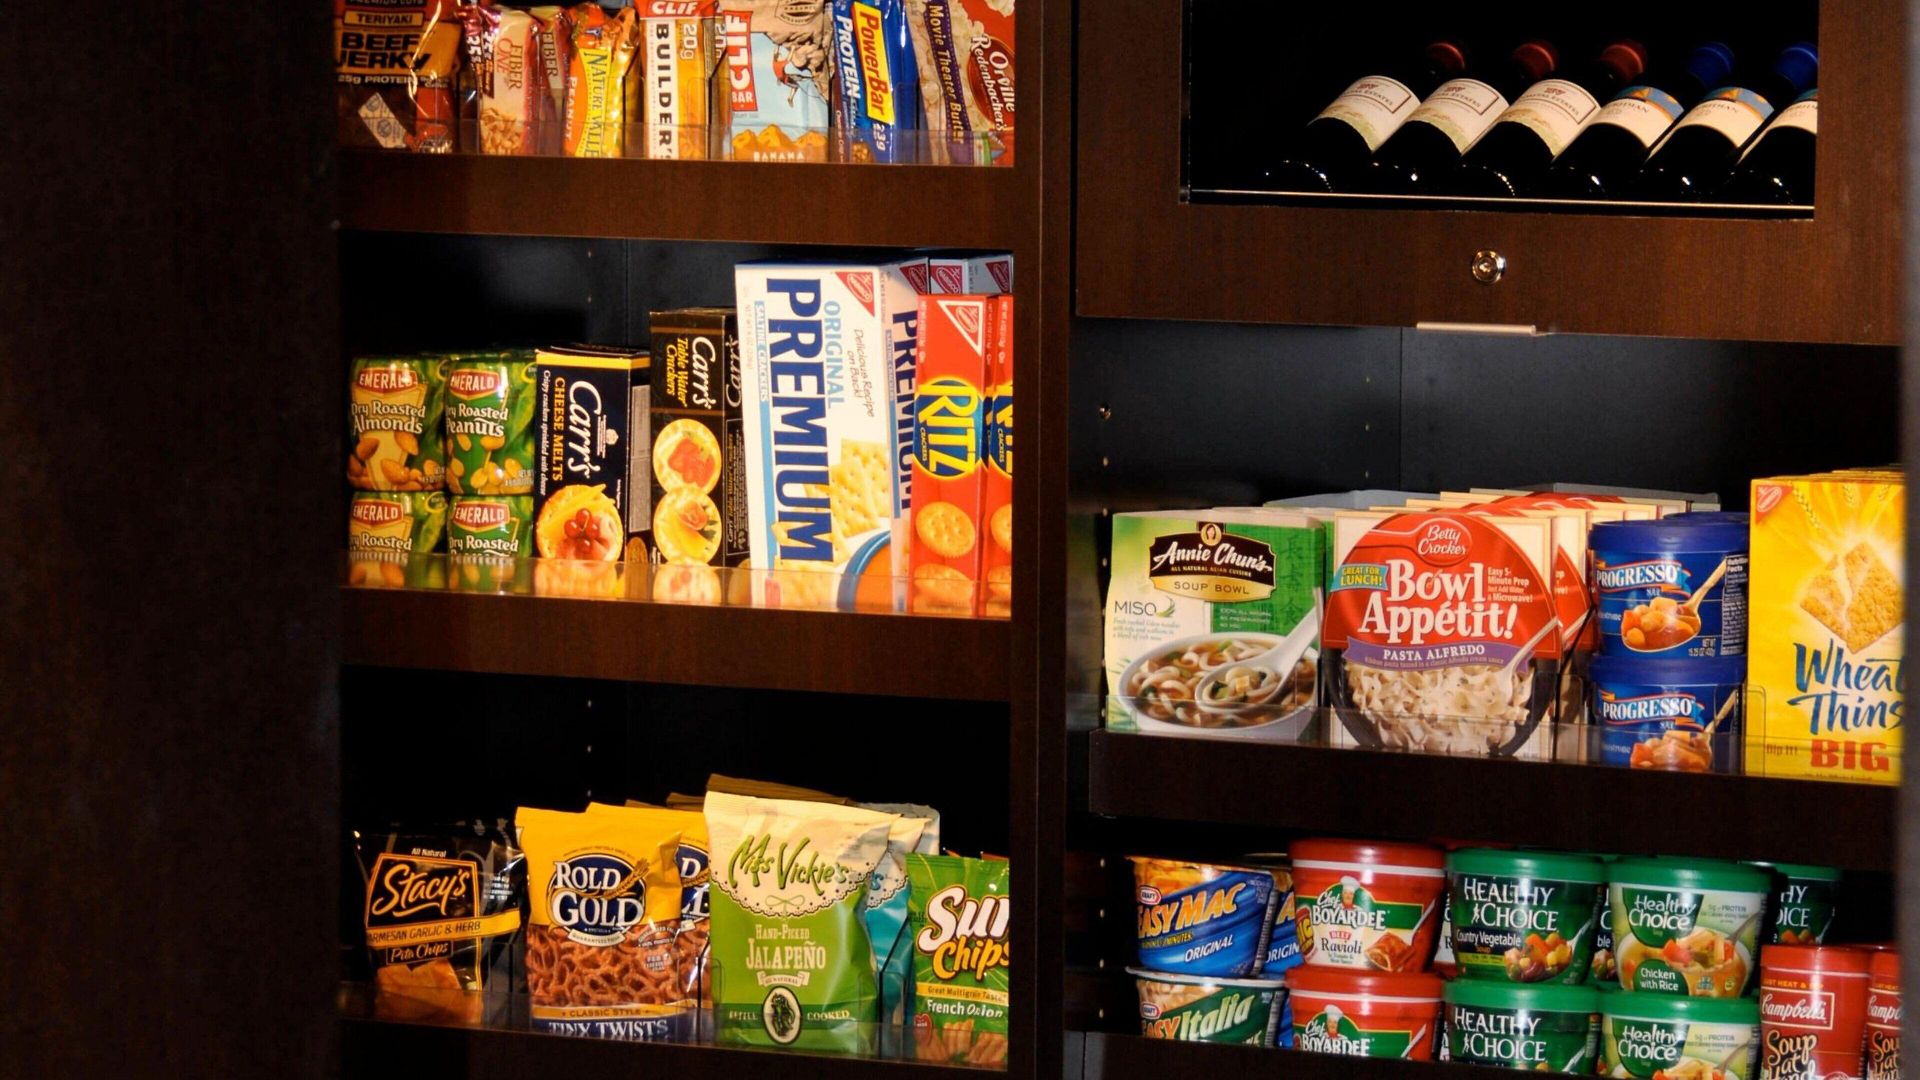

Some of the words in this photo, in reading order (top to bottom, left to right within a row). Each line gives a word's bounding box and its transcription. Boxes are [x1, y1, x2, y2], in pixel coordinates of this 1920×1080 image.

[358, 14, 413, 25] TERIYAKI
[651, 1, 698, 15] CLIF
[341, 32, 421, 50] BEEF
[680, 23, 698, 61] 20g
[725, 15, 751, 90] CLIF
[338, 50, 431, 71] JERKY
[497, 38, 510, 74] ONE
[541, 32, 559, 77] FIBER
[836, 15, 861, 99] PROTEIN
[860, 11, 889, 116] PowerBar
[509, 44, 523, 90] FIBER
[929, 5, 947, 46] Movie
[940, 50, 957, 99] Theater
[949, 103, 964, 145] Butter
[337, 75, 362, 84] 25g
[364, 75, 417, 83] PROTEIN
[586, 51, 608, 110] NATURE
[970, 34, 1004, 132] Redenbacher's
[989, 51, 1015, 113] Orville
[565, 76, 579, 141] PEANUT
[731, 92, 753, 104] BAR
[873, 124, 887, 151] 23g
[753, 152, 804, 162] BANANA
[755, 303, 766, 344] SALTINE
[677, 337, 689, 367] Table
[824, 301, 845, 408] ORIGINAL
[849, 350, 857, 365] on
[359, 373, 413, 390] EMERALD
[541, 369, 551, 393] Crispy
[664, 344, 677, 396] Crackers
[691, 336, 717, 410] Carr's
[757, 346, 768, 402] CRACKERS
[854, 328, 868, 380] Delicious
[862, 381, 875, 418] Recipe
[450, 373, 495, 391] EMERALD
[676, 369, 689, 407] Water
[351, 403, 369, 416] Dry
[372, 400, 426, 418] Roasted
[458, 403, 509, 421] Roasted
[541, 394, 549, 423] crackers
[554, 376, 566, 430] CHEESE
[353, 415, 424, 434] Almonds
[448, 417, 505, 437] Peanuts
[567, 380, 602, 479] Carr's
[766, 278, 834, 562] PREMIUM
[918, 383, 979, 473] RITZ
[553, 432, 565, 482] MELTS
[353, 502, 399, 520] EMERALD
[455, 506, 506, 523] EMERALD
[361, 532, 413, 550] Roasted
[466, 535, 519, 552] Roasted
[1427, 525, 1462, 545] Betty
[1151, 541, 1211, 571] Annie
[1213, 543, 1273, 572] Chun's
[1417, 538, 1467, 556] Crocker
[1229, 568, 1252, 578] CUISINE
[1340, 575, 1383, 587] LUNCH!
[1342, 567, 1363, 576] GREAT
[1365, 567, 1380, 576] FOR
[1385, 559, 1486, 602] Bowl
[1487, 567, 1503, 578] Easy
[1487, 576, 1512, 585] Minute
[1513, 577, 1530, 588] Prep
[1597, 564, 1680, 587] PROGRESSO
[1174, 581, 1209, 592] SOUP
[1215, 584, 1250, 594] BOWL
[1114, 601, 1157, 616] MISO
[1357, 591, 1518, 645] Appétit!
[1383, 649, 1422, 661] PASTA
[1427, 645, 1485, 661] ALFREDO
[1793, 638, 1904, 695] Wheat
[1603, 698, 1694, 720] PROGRESSO
[1787, 692, 1904, 736] Thins
[1811, 738, 1889, 772] BIG
[411, 847, 420, 856] All
[421, 848, 447, 858] Natural
[553, 861, 622, 892] ROLD
[777, 836, 849, 896] Vickie's
[371, 862, 471, 918] Stacy's
[1317, 890, 1340, 908] Chef
[1464, 877, 1556, 906] HEALTHY
[552, 890, 645, 926] GOLD
[1634, 894, 1698, 916] Healthy
[917, 885, 1009, 955] Sun
[1312, 904, 1386, 930] BOYARDEE
[1480, 903, 1559, 931] CHOICE
[1628, 910, 1691, 930] Choice
[409, 925, 443, 939] GARLIC
[445, 924, 453, 934] &
[455, 921, 481, 933] HERB
[755, 923, 810, 941] HAND-PICKED
[1456, 929, 1479, 943] Country
[1479, 931, 1522, 947] Vegetable
[391, 947, 415, 963] Pita
[416, 942, 448, 959] Chips
[746, 937, 826, 970] JALAPEÑO
[1184, 934, 1233, 963] ORIGINAL
[1321, 938, 1363, 954] Ravioli
[1640, 967, 1676, 980] Chicken
[1777, 980, 1797, 988] HEAT
[928, 985, 945, 996] Great
[1640, 980, 1658, 990] with
[1659, 980, 1679, 991] Rice
[569, 1008, 612, 1018] CLASSIC
[613, 1007, 642, 1017] STYLE
[806, 1010, 850, 1021] COOKED
[927, 999, 965, 1016] French
[966, 1002, 1004, 1018] Onion
[1179, 993, 1255, 1040] Italia
[1761, 993, 1827, 1024] Campbell's
[596, 1019, 669, 1040] TWISTS
[1305, 1019, 1326, 1036] Chef
[1454, 1008, 1542, 1037] HEALTHY
[1302, 1035, 1371, 1057] BOYARDEE
[1470, 1033, 1547, 1061] CHOICE
[1622, 1024, 1678, 1047] Healthy
[1618, 1039, 1678, 1060] Choice
[1767, 1030, 1817, 1067] Soup
[1781, 1055, 1799, 1075] at
